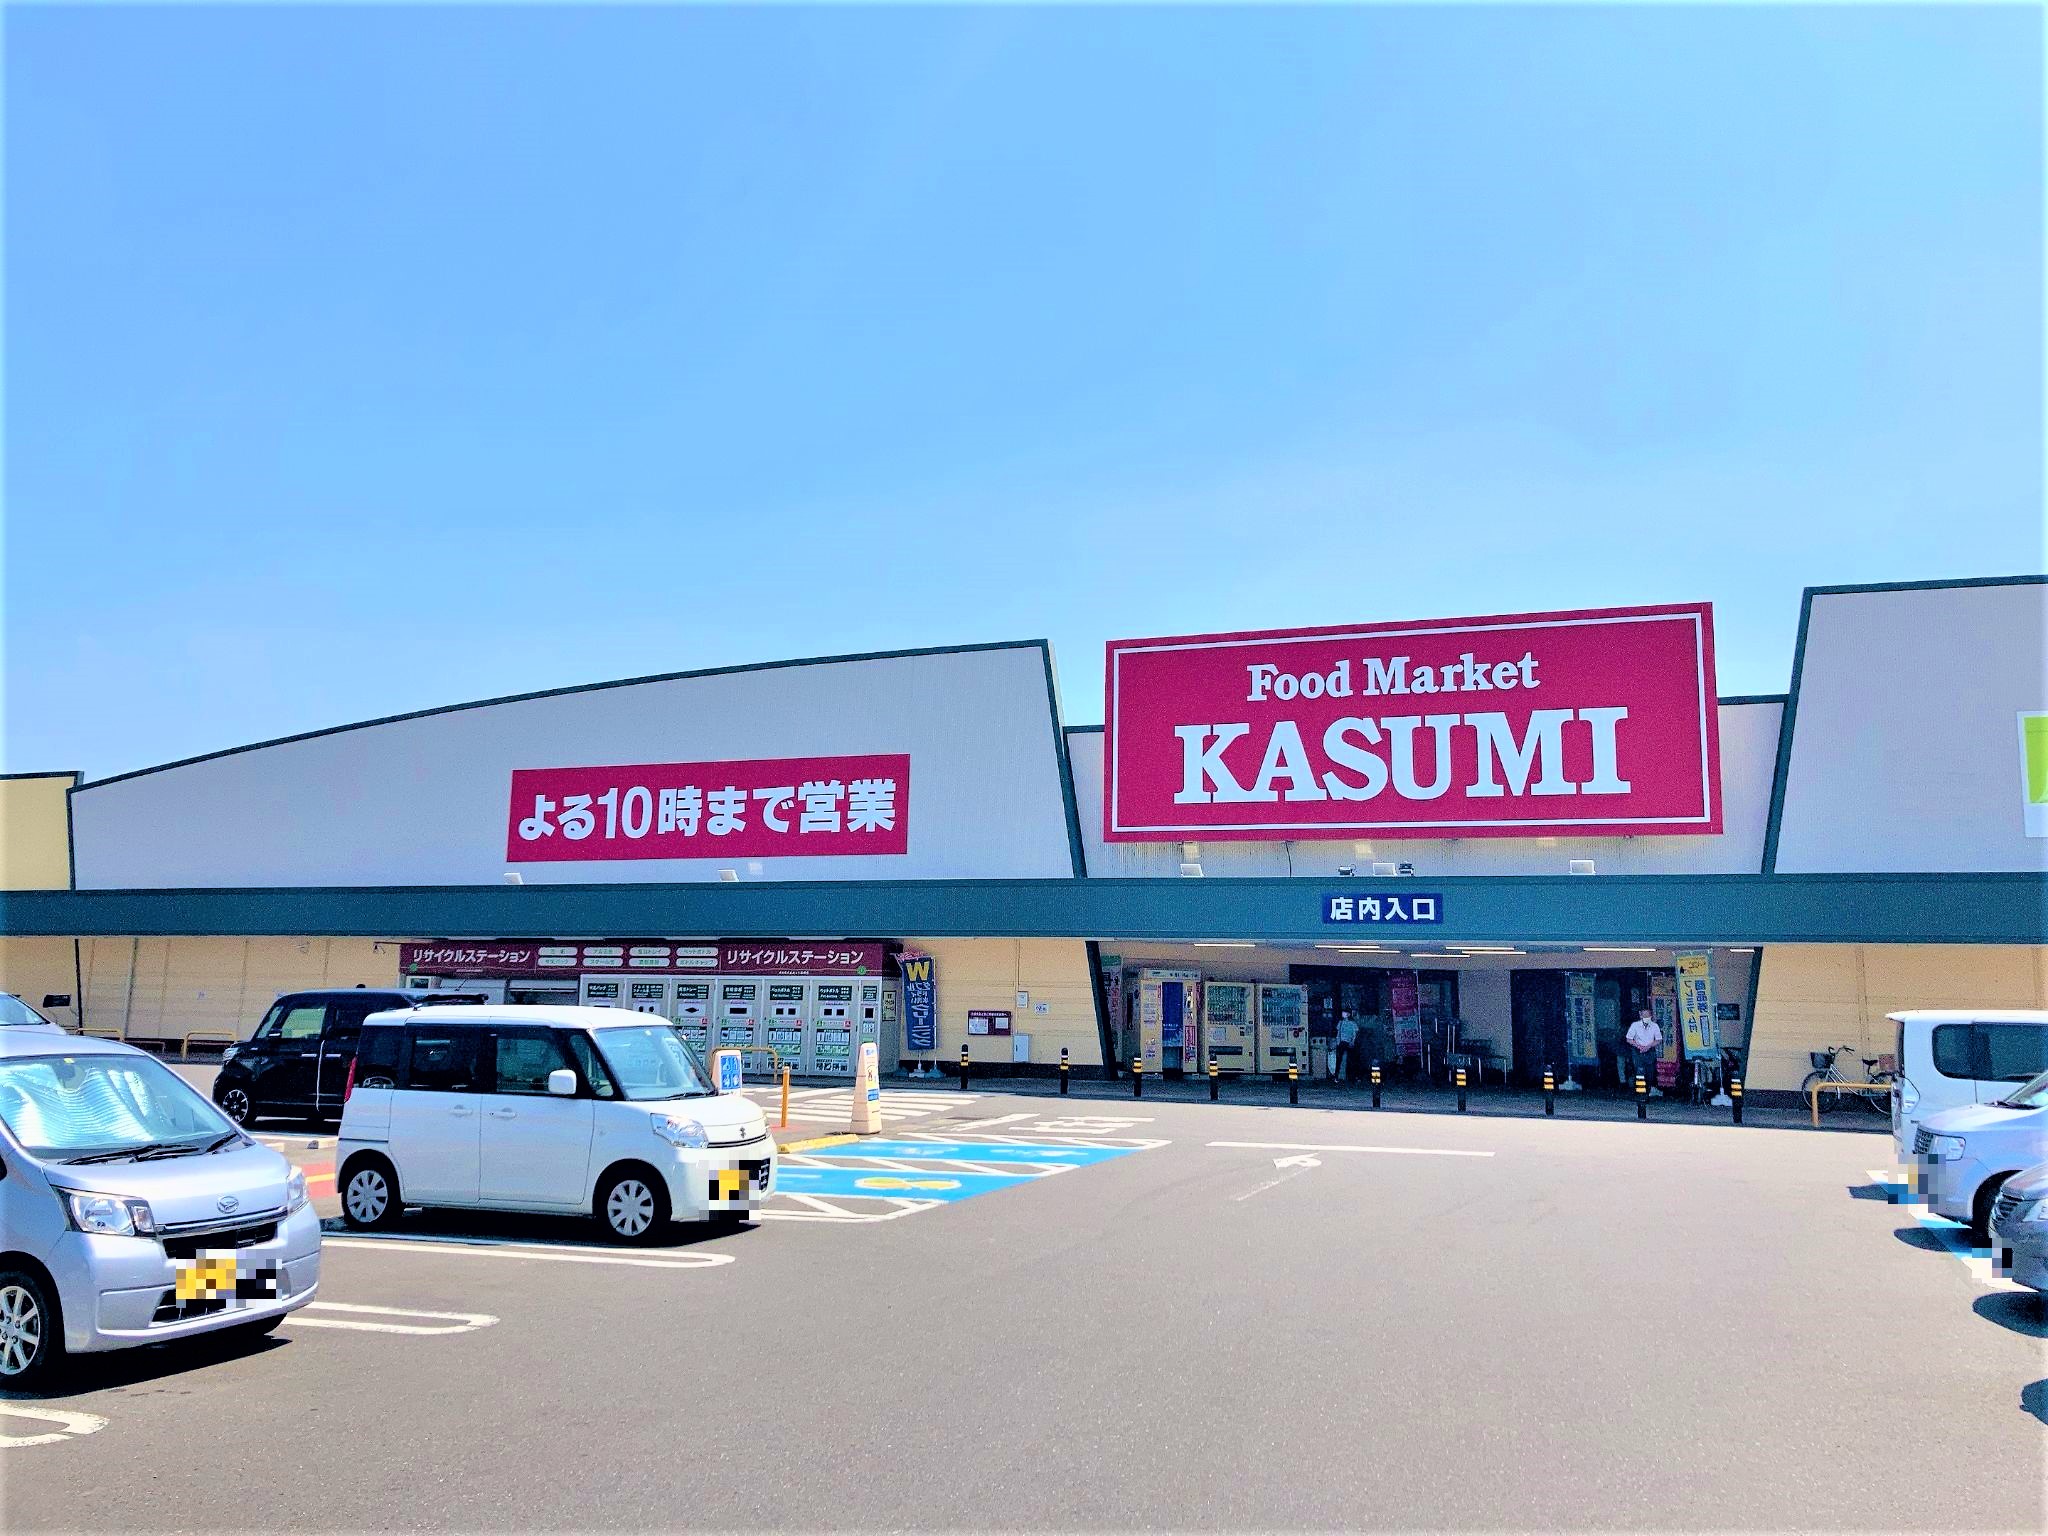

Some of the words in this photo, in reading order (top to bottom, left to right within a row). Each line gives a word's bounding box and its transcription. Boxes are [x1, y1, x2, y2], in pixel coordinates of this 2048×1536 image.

[1247, 659, 1353, 702] Food
[1362, 651, 1541, 696] Market
[1173, 706, 1632, 805] KASUMI
[518, 778, 897, 841] よる10時まで営業
[1330, 896, 1435, 921] 店内入口
[413, 948, 531, 963] リサイクルステーション
[727, 949, 864, 965] リサイクルステーション
